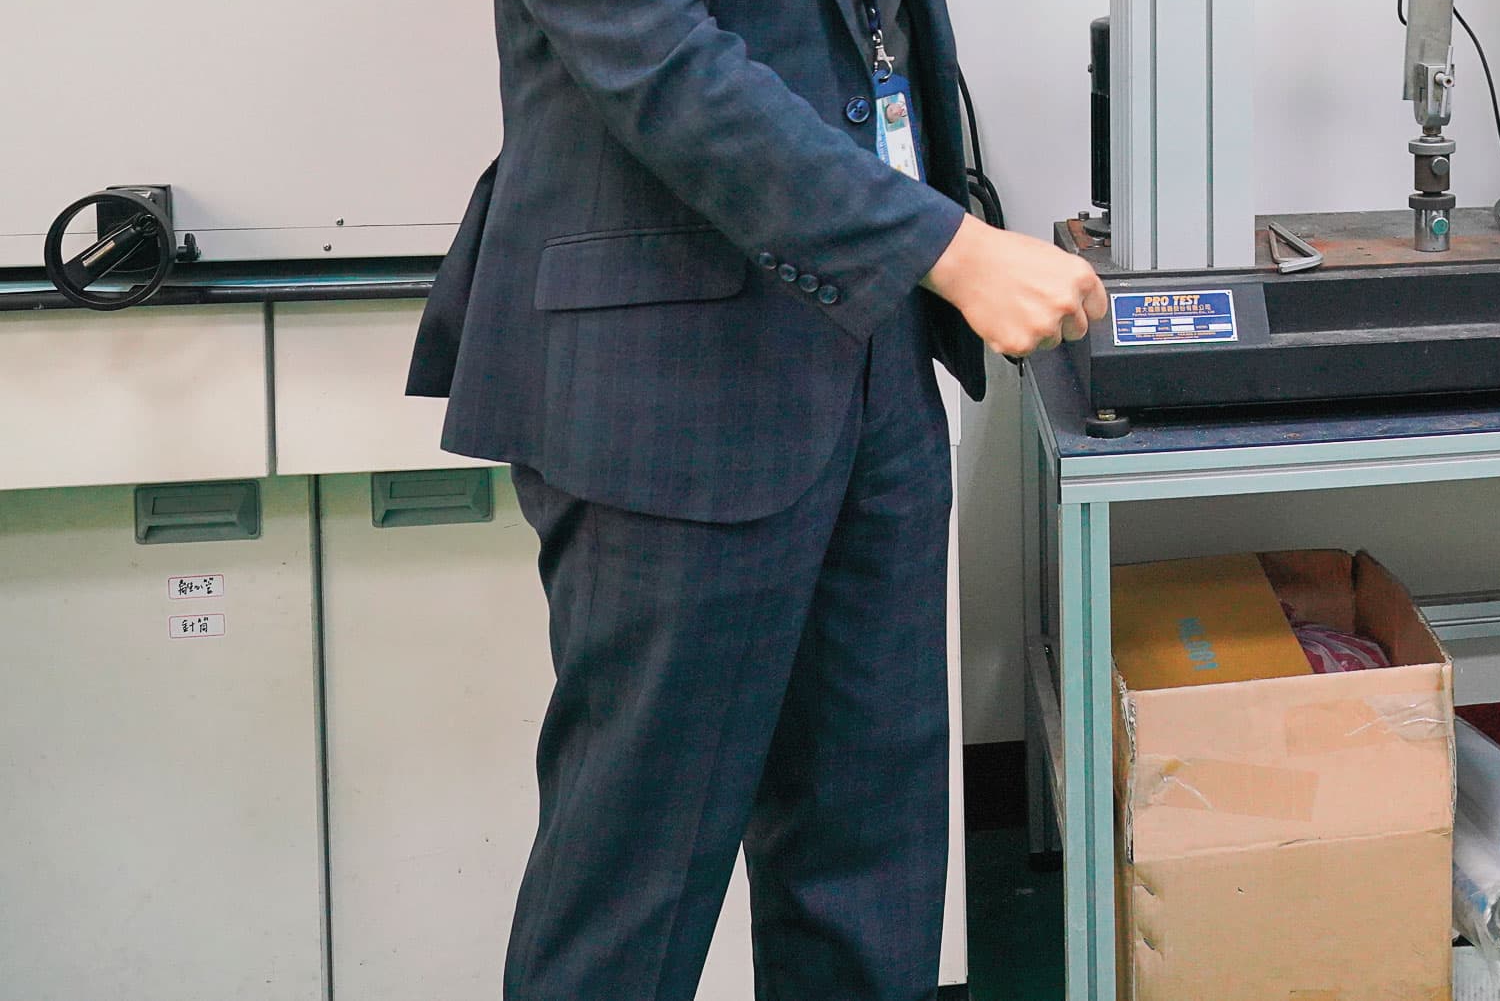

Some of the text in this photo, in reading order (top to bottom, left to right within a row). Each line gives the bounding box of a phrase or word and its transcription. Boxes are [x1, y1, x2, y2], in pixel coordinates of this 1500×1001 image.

[1144, 294, 1201, 306] PRO TEST
[181, 616, 209, 633] 針筒
